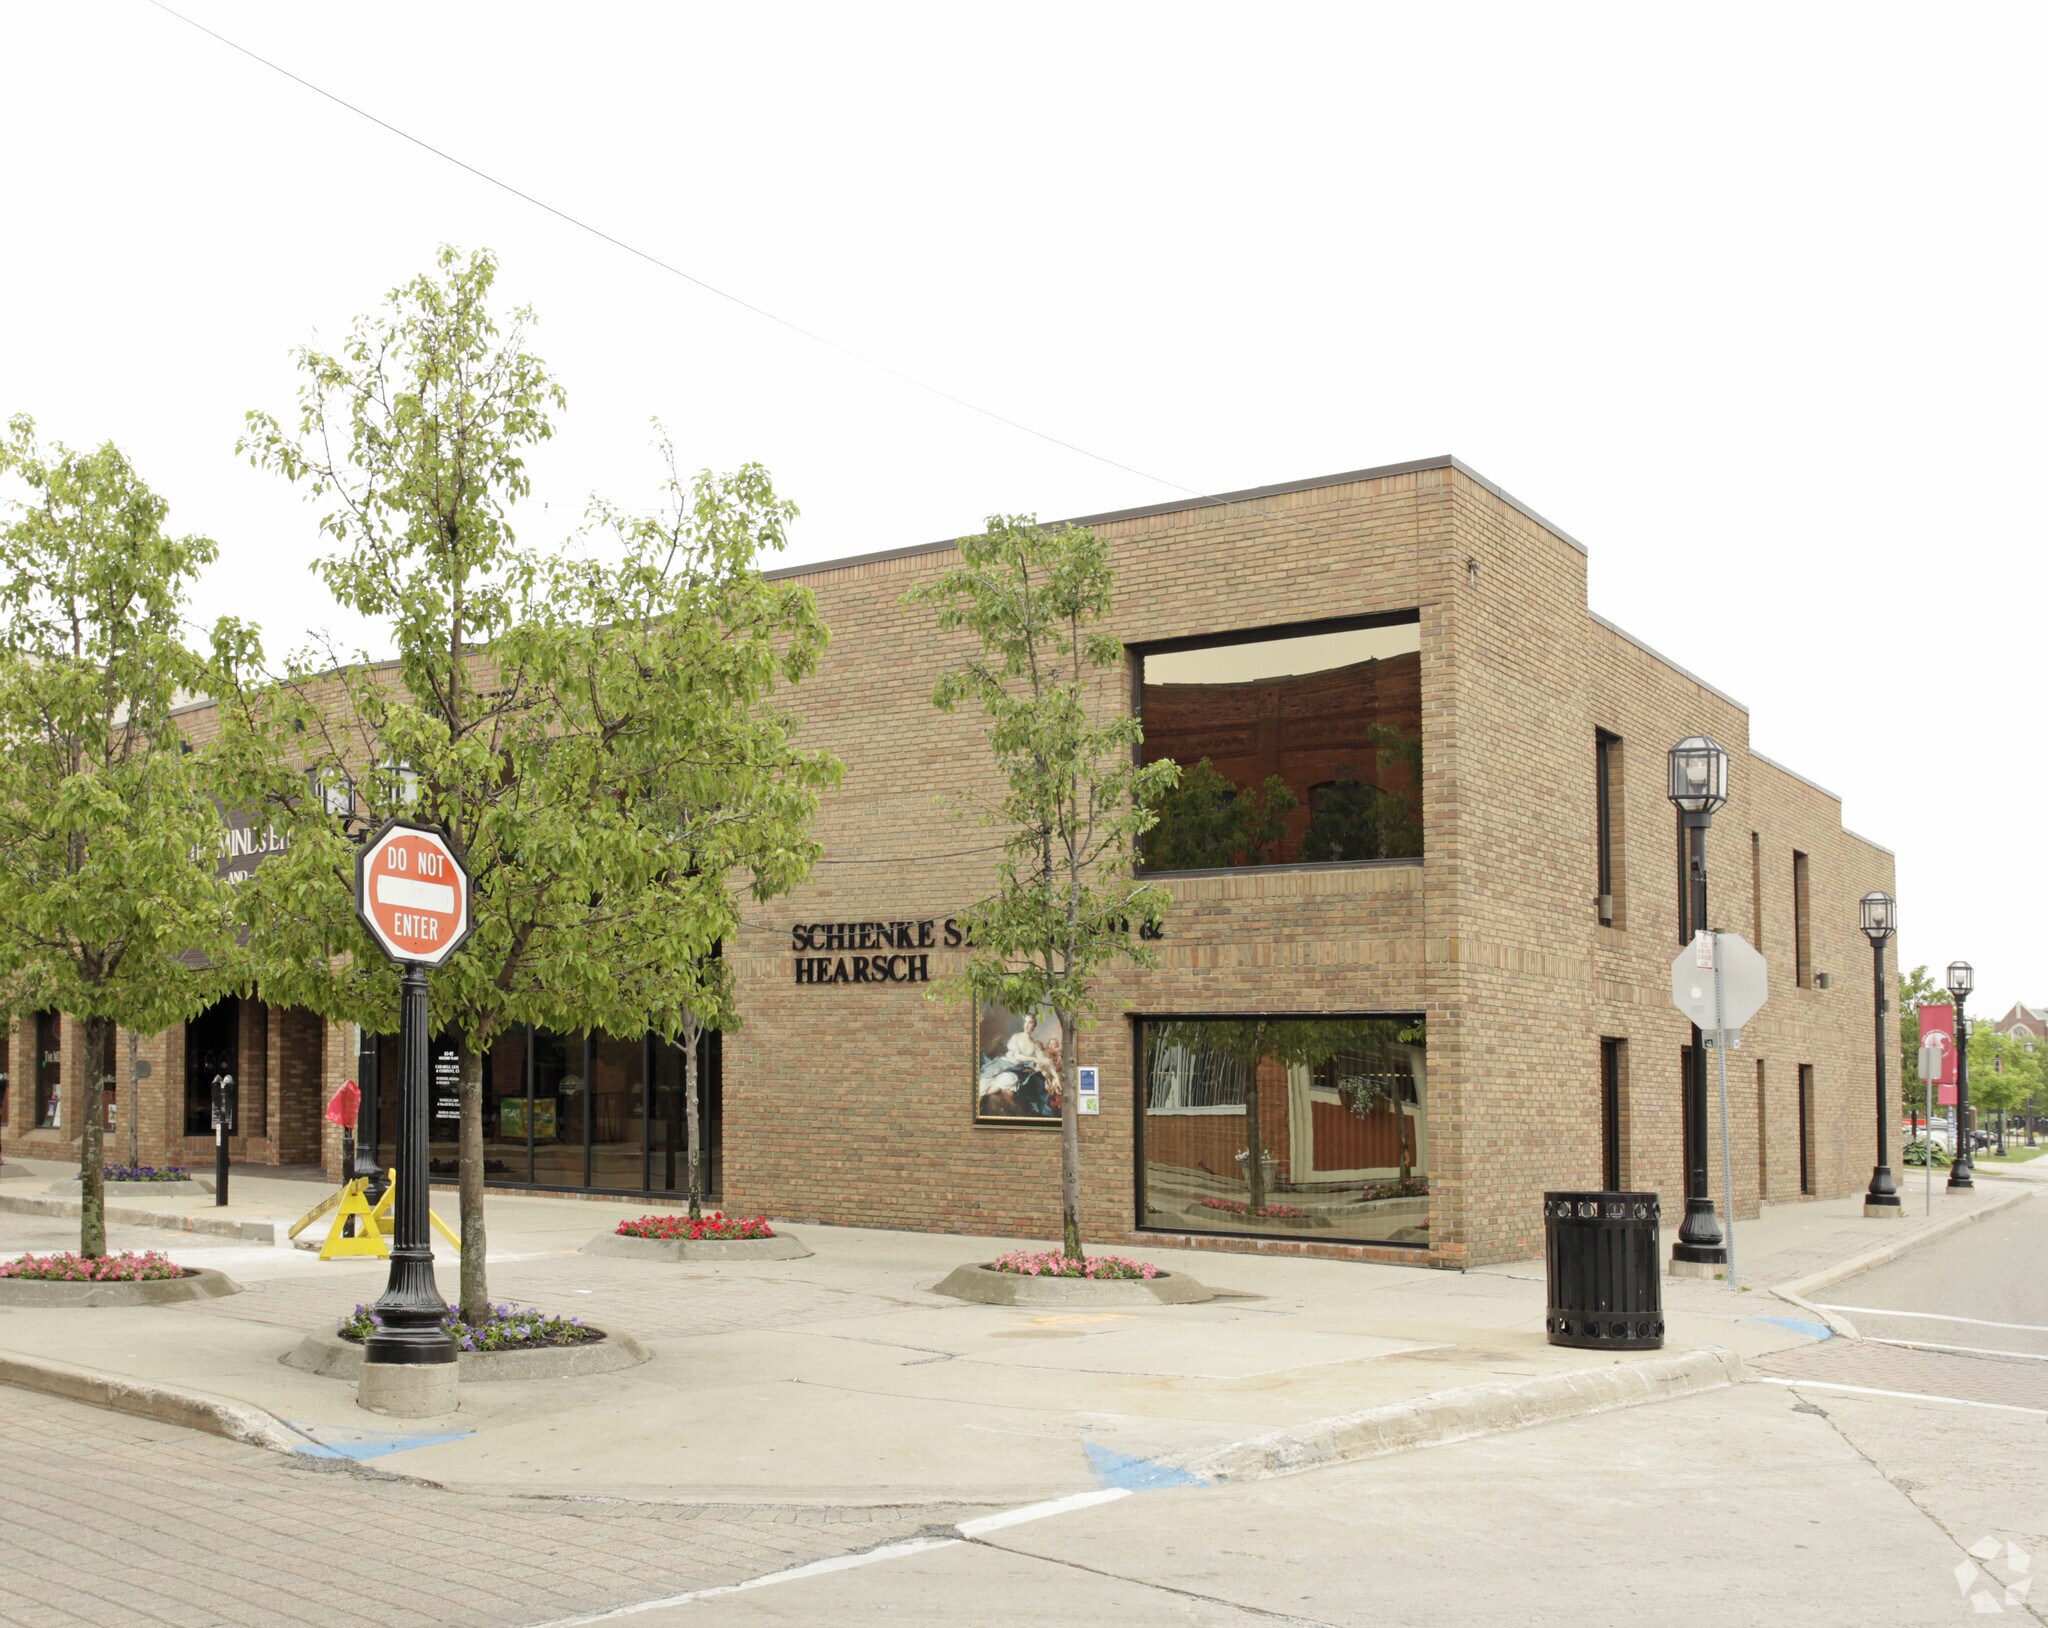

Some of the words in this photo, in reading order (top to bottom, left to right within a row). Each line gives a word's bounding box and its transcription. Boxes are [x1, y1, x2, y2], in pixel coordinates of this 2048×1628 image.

[388, 846, 407, 871] DO
[418, 852, 445, 878] NOT
[394, 912, 438, 941] ENTER
[792, 920, 936, 950] SCHIENKE
[795, 954, 930, 984] HEARSCH
